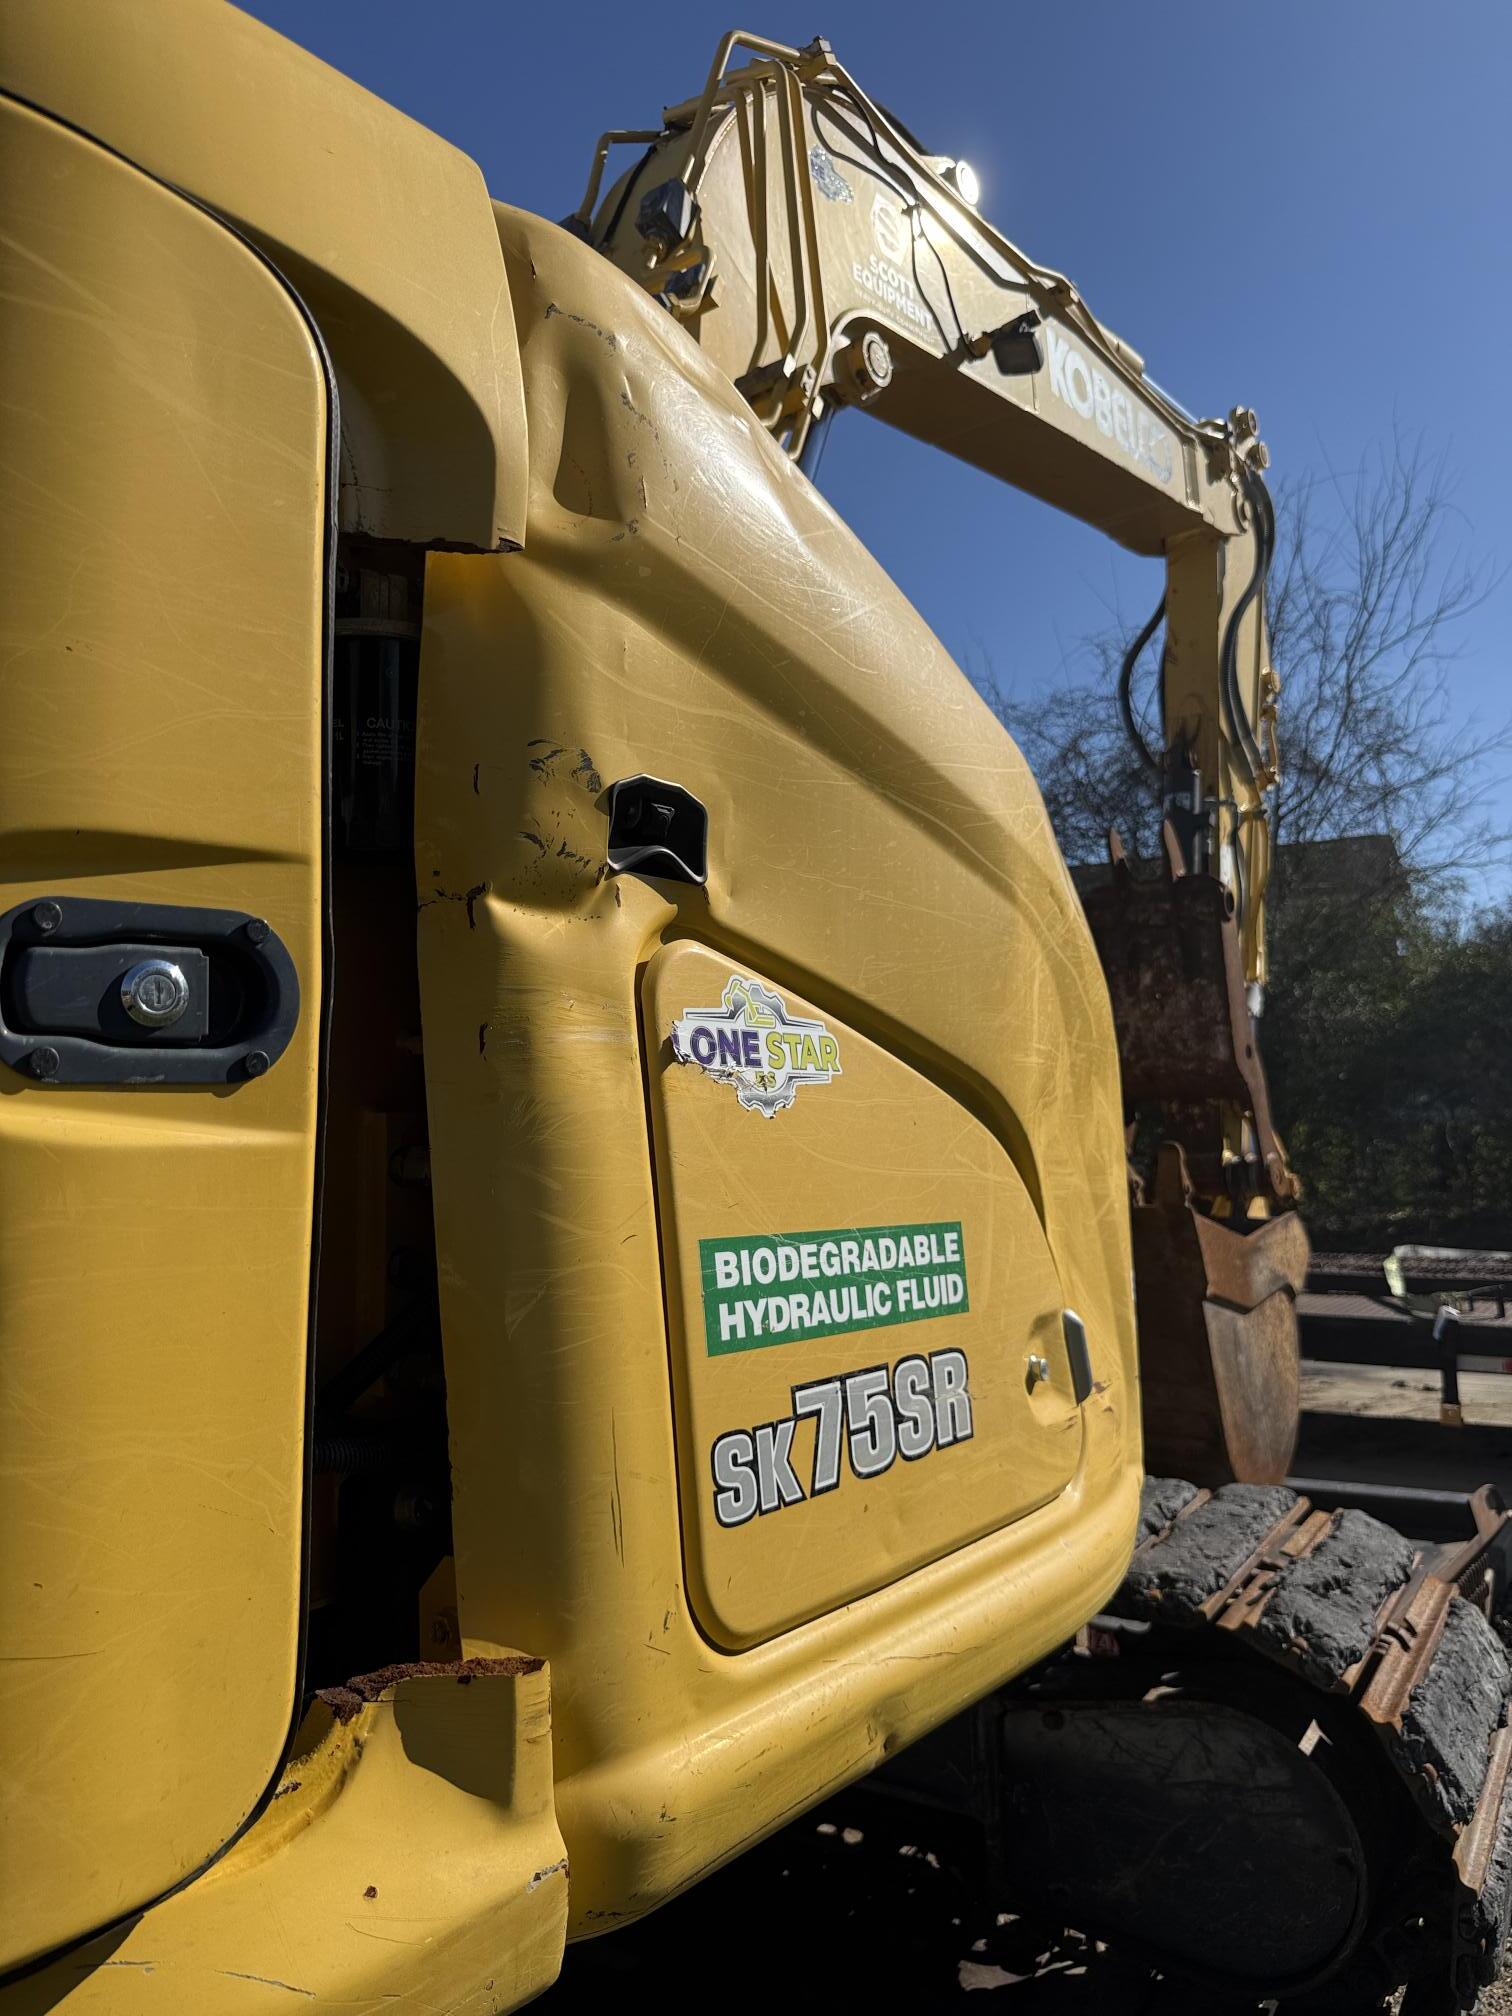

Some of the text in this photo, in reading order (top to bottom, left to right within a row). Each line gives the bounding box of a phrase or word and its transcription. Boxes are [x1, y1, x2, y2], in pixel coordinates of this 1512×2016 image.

[853, 262, 933, 330] EQUIPMENT
[868, 255, 915, 299] SCOTT
[690, 1026, 840, 1072] ONE STAR
[714, 1232, 961, 1289] BIODEGRADABLE
[718, 1273, 964, 1341] HYDRAULIC FLUID
[711, 1347, 973, 1528] SK75SR
